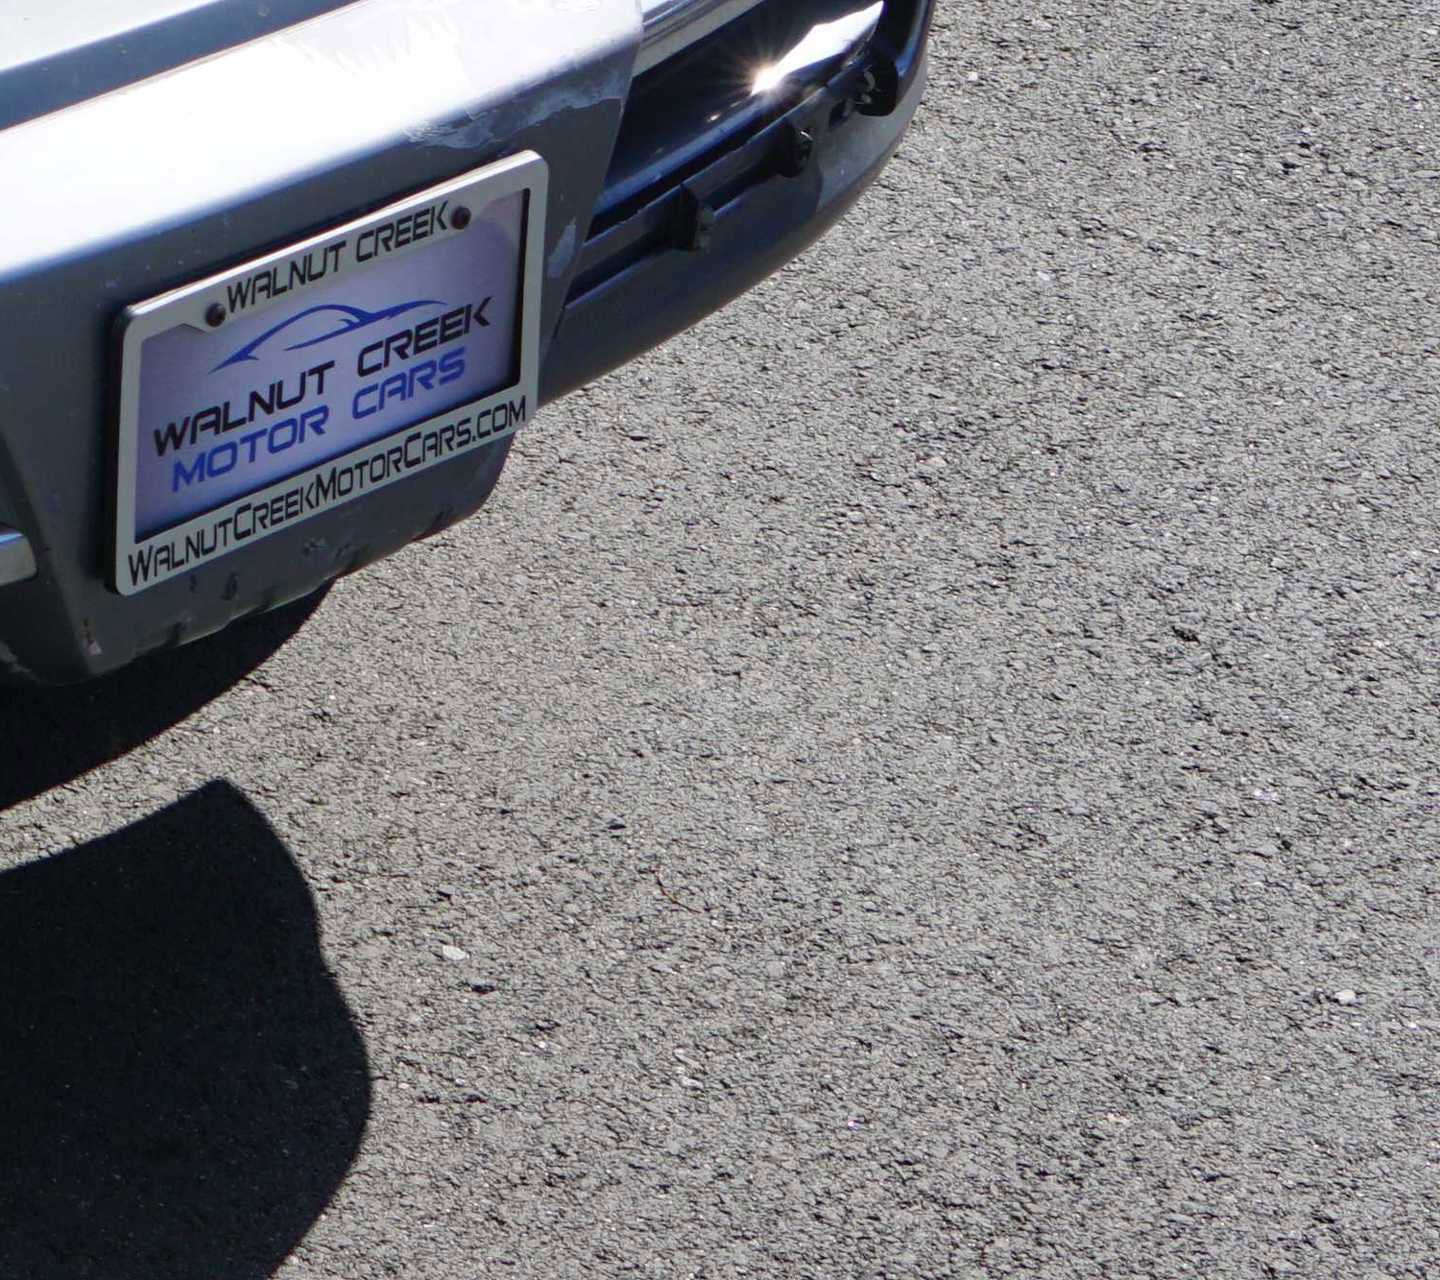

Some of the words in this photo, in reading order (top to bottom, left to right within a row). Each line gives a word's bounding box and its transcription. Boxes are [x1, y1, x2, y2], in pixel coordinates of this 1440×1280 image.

[227, 240, 346, 313] WALNUT
[355, 200, 449, 263] CREEK
[153, 360, 335, 457] WALNUT
[357, 297, 493, 379] CREEK
[171, 405, 330, 493] MOTOR
[352, 346, 466, 420] CARS
[128, 395, 527, 586] WALNUTCREEKMOTORCARS.COM
